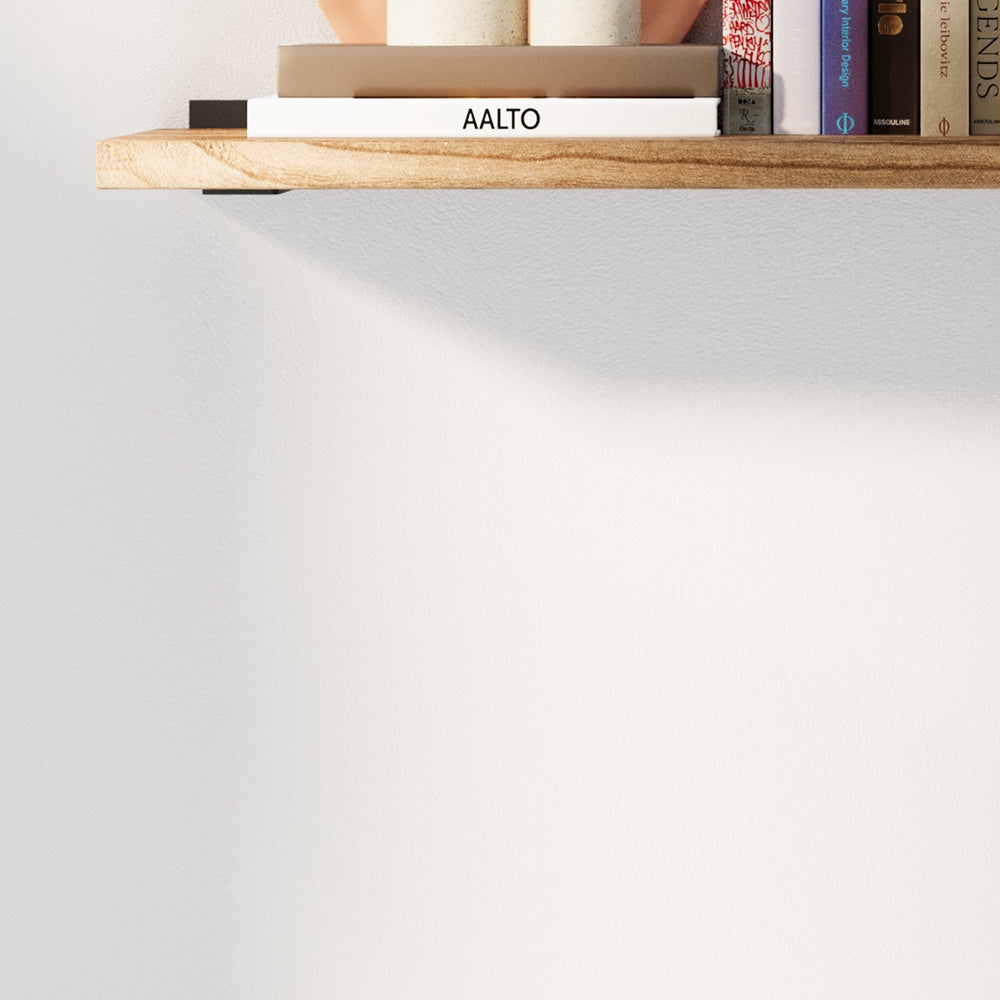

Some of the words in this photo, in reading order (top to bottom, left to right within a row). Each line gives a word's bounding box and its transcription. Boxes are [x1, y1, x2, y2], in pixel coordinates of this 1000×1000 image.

[841, 17, 851, 51] Interior
[939, 17, 950, 78] leibovitz
[839, 54, 851, 87] Design
[463, 108, 540, 129] AALTO
[872, 118, 911, 126] ASSOULINE
